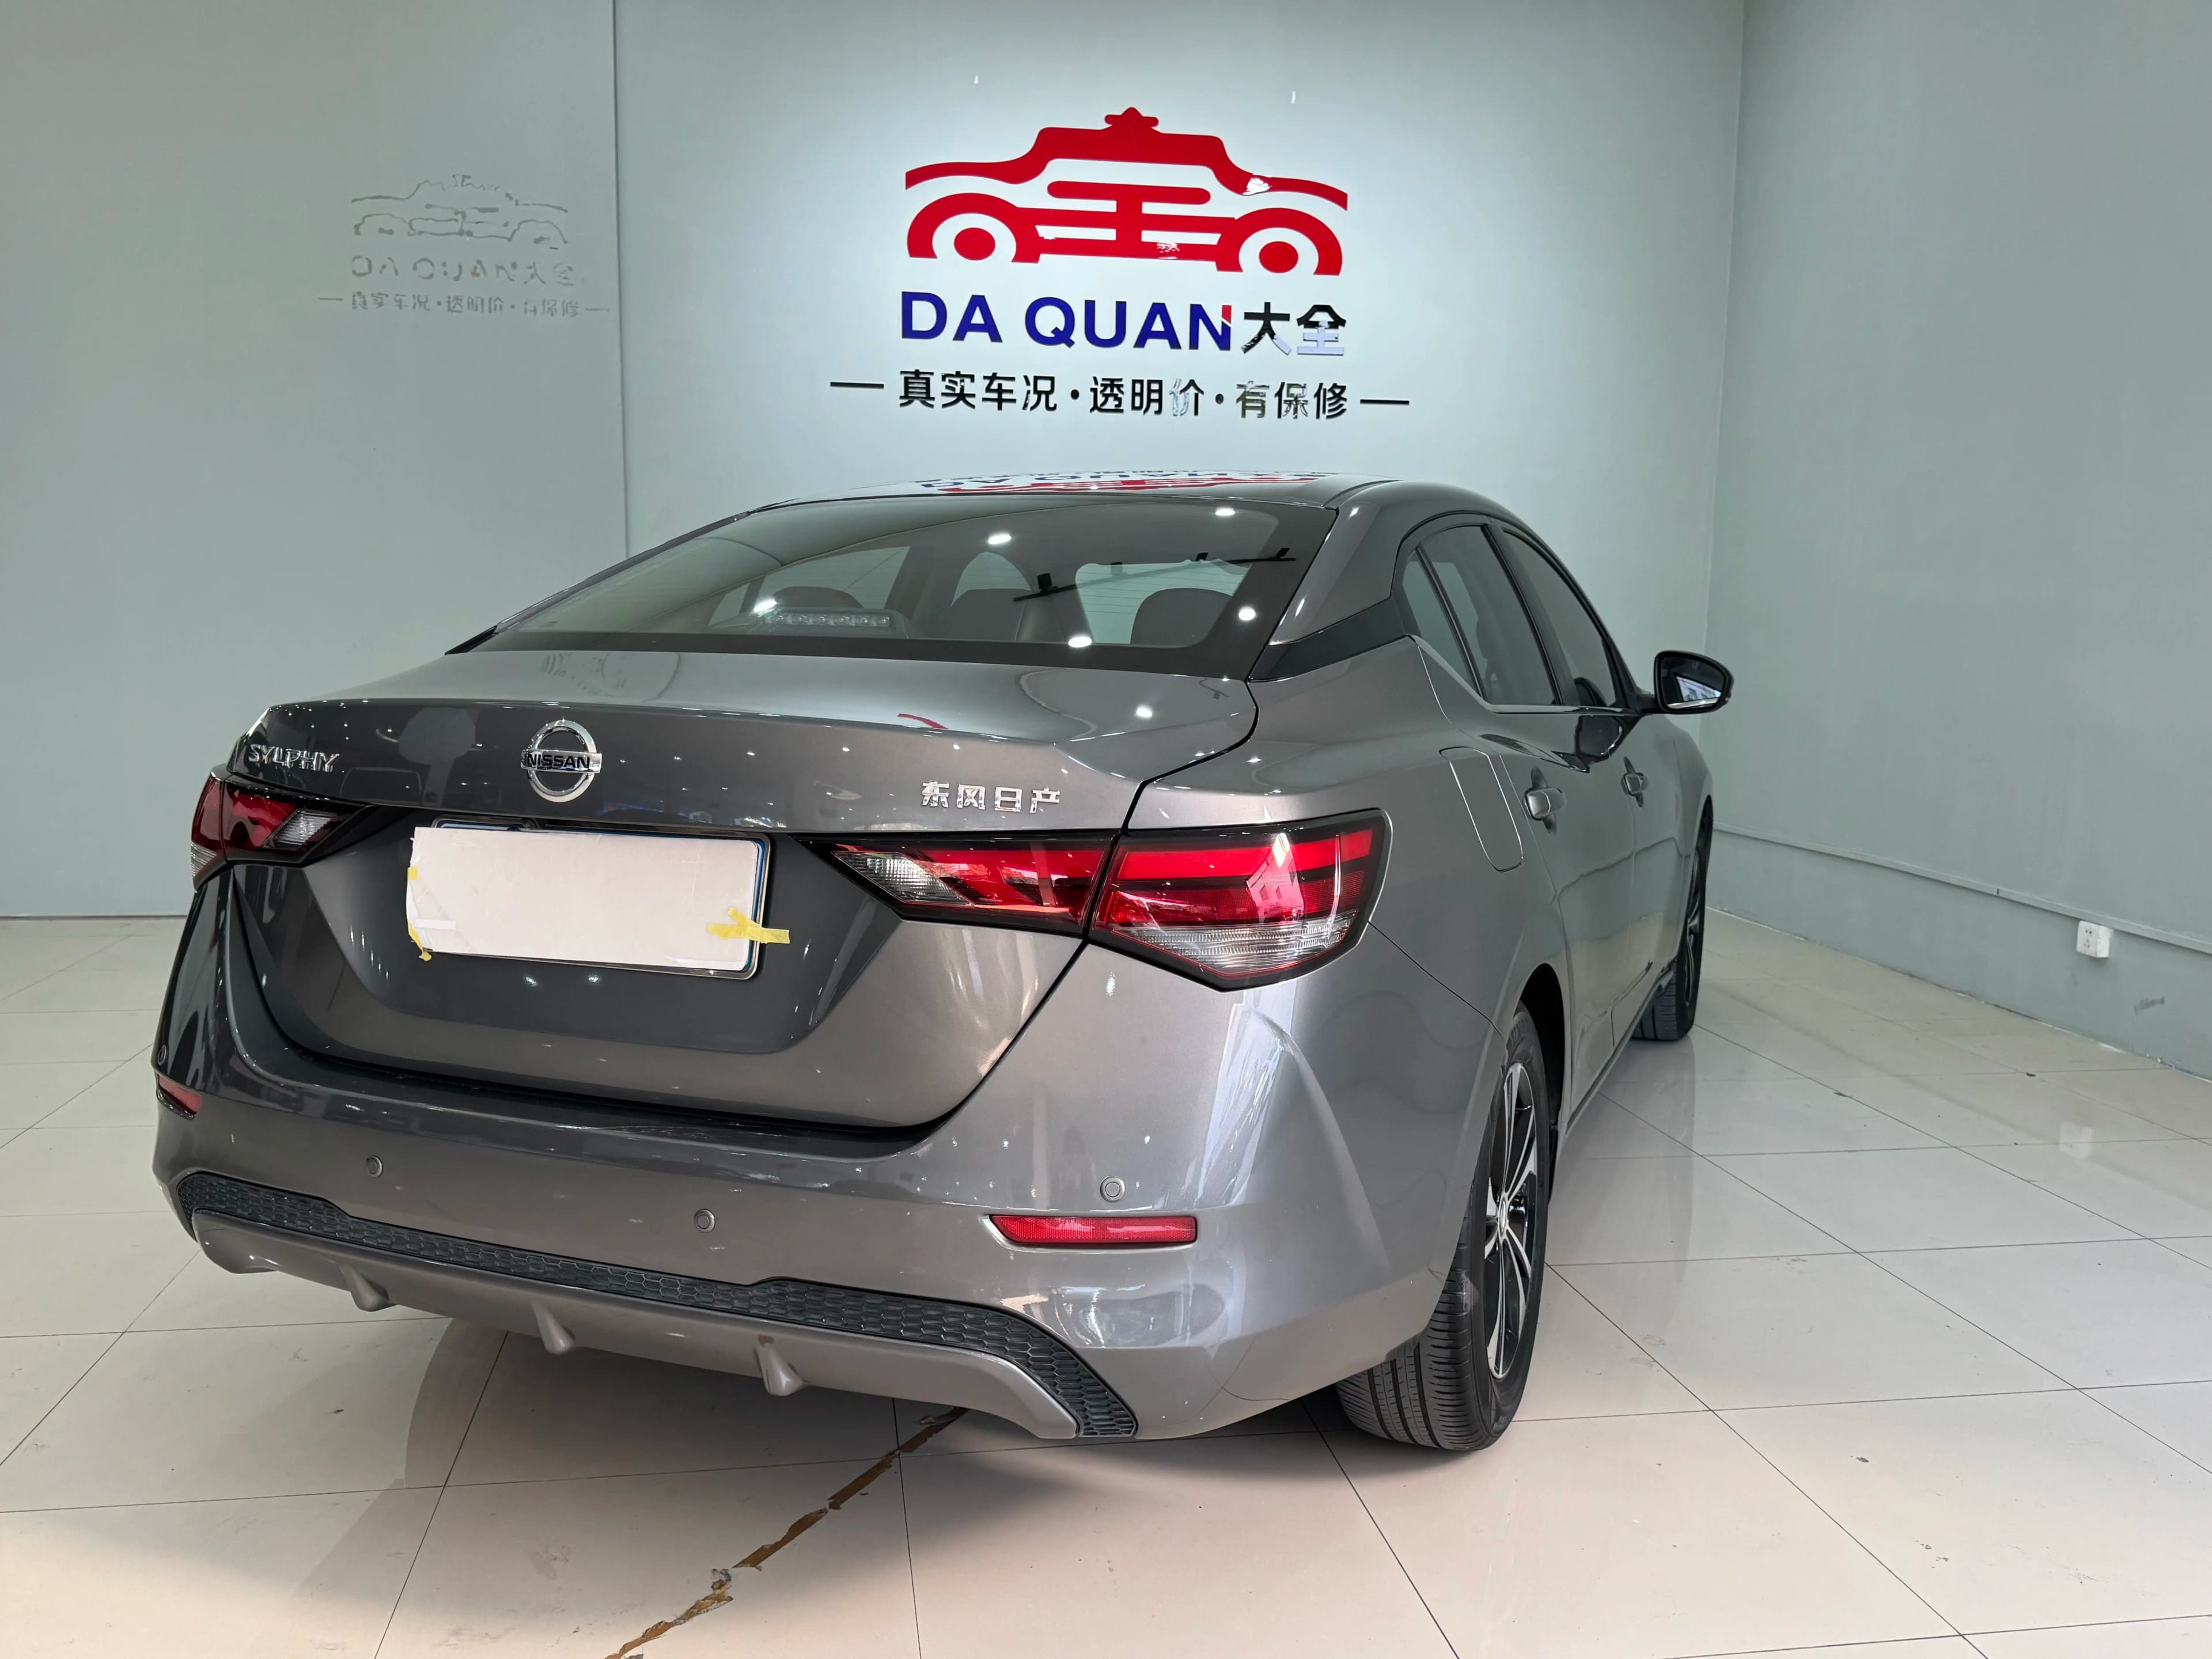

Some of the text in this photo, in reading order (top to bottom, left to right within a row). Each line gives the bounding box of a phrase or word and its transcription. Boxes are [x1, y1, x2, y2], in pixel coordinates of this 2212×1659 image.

[902, 291, 1003, 343] DA
[1240, 301, 1347, 357] 大全
[248, 744, 340, 772] SYLPHY
[527, 753, 591, 770] NISSAN
[921, 781, 1060, 813] 东风日产
